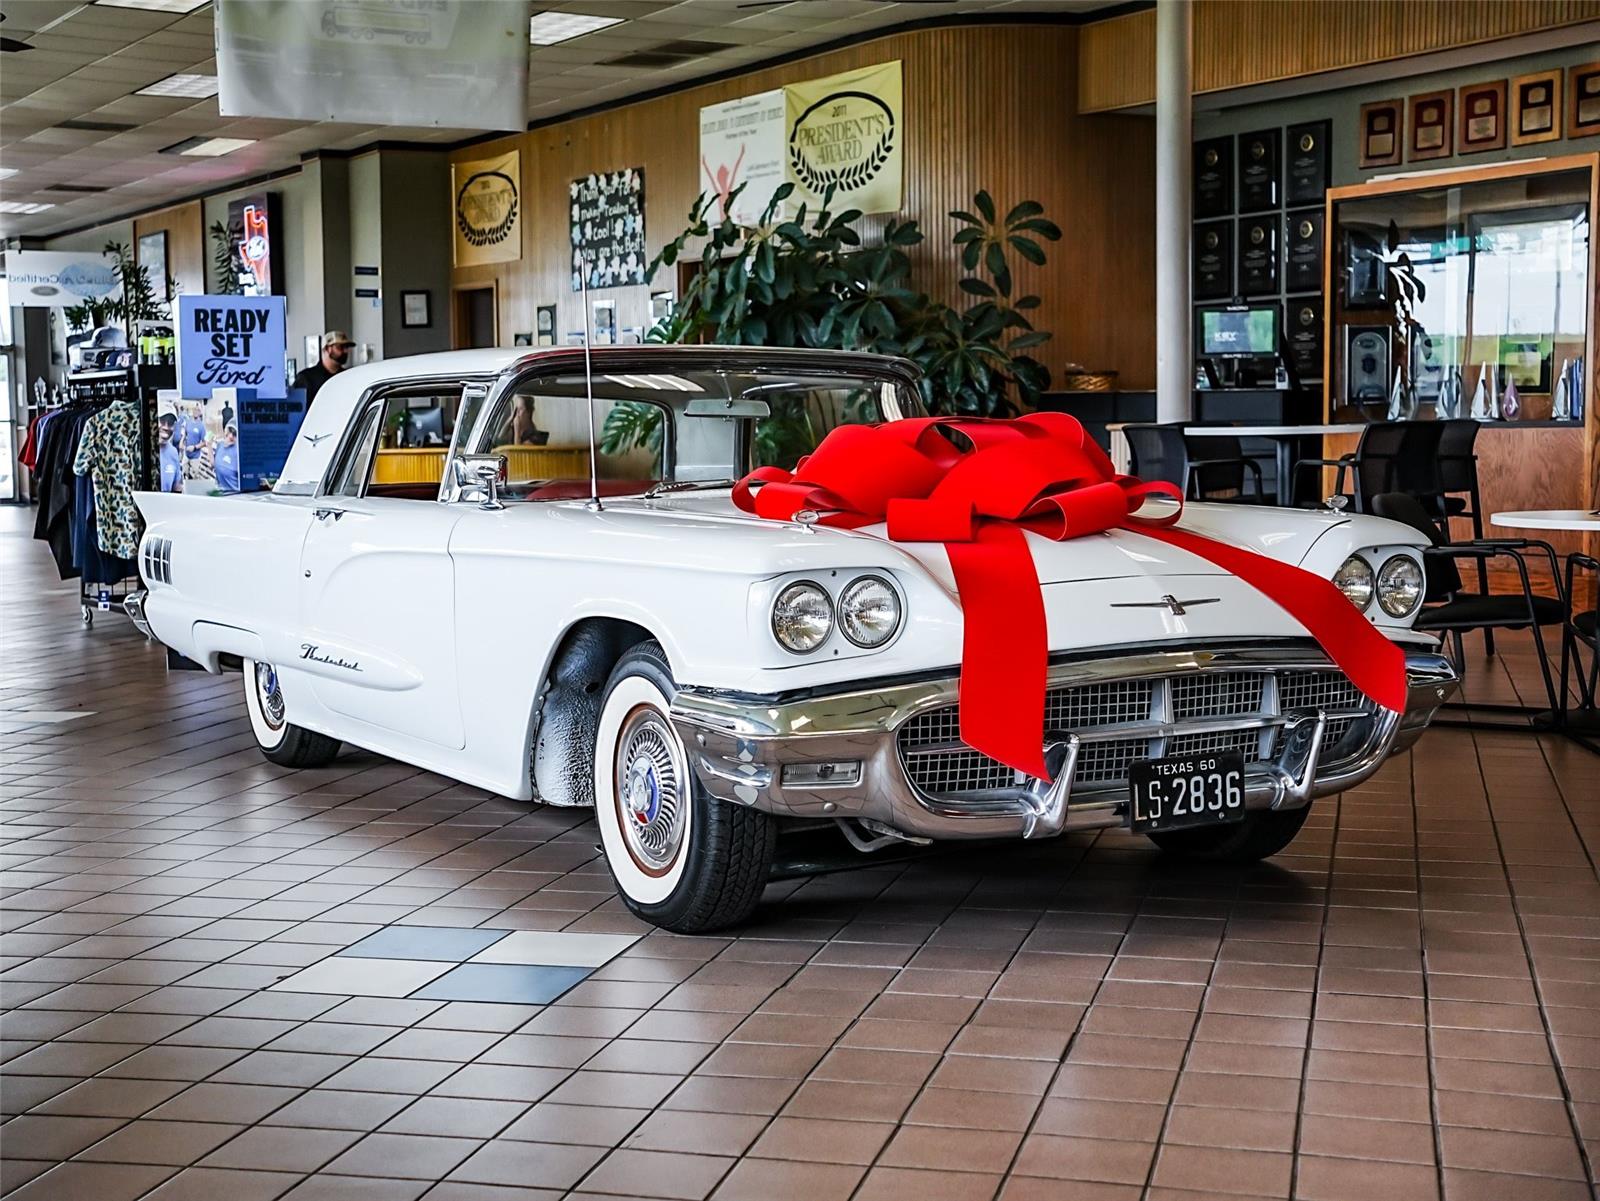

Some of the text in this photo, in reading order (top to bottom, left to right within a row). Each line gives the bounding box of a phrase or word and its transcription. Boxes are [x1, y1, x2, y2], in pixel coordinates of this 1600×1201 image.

[798, 113, 885, 147] PRESIDENT'S
[815, 139, 863, 165] AWARD
[194, 308, 270, 333] READY
[211, 333, 253, 357] SET
[196, 357, 266, 385] Ford
[299, 643, 364, 672] Thunderbird
[1156, 759, 1216, 775] TEXAS 60
